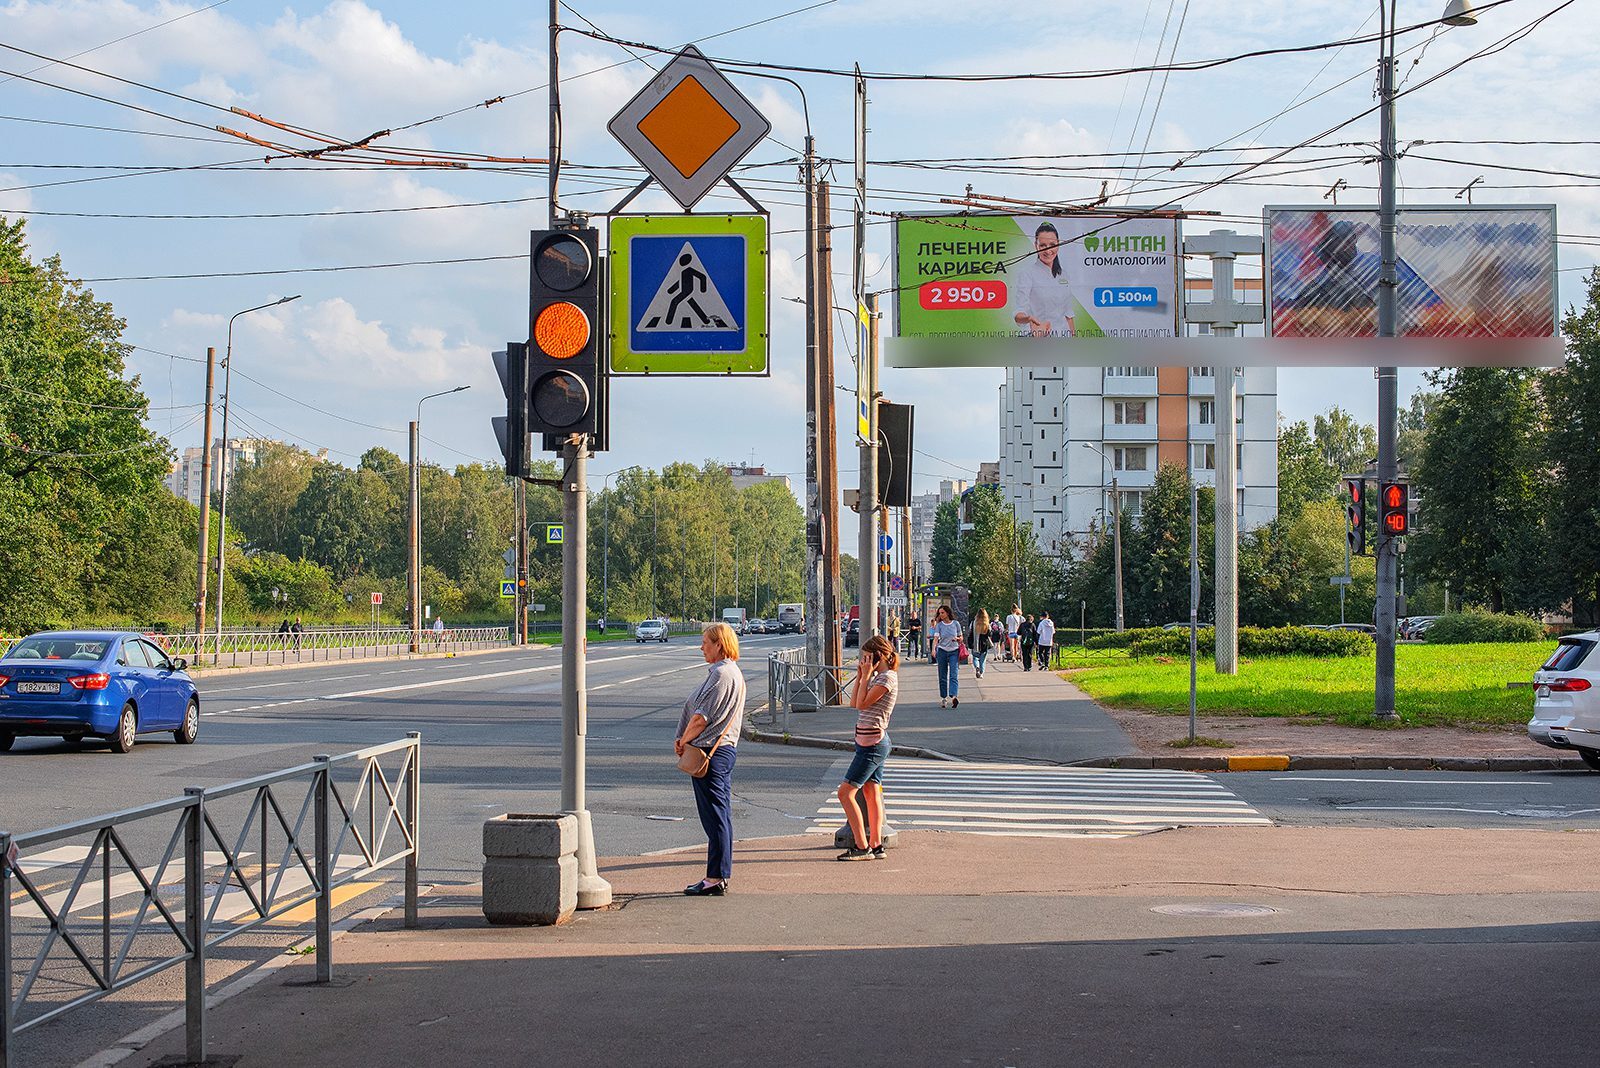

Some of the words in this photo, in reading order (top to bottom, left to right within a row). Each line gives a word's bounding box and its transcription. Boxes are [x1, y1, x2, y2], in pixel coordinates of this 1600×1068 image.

[917, 241, 1006, 256] ЛЕЧЕНИЕ
[1103, 235, 1166, 252] ИНТАН
[918, 261, 1007, 275] КАРИЕСА
[1084, 256, 1166, 266] СТОМАТОЛОГИИ
[931, 288, 943, 303] 2
[947, 287, 984, 303] 950
[1387, 515, 1404, 530] 40
